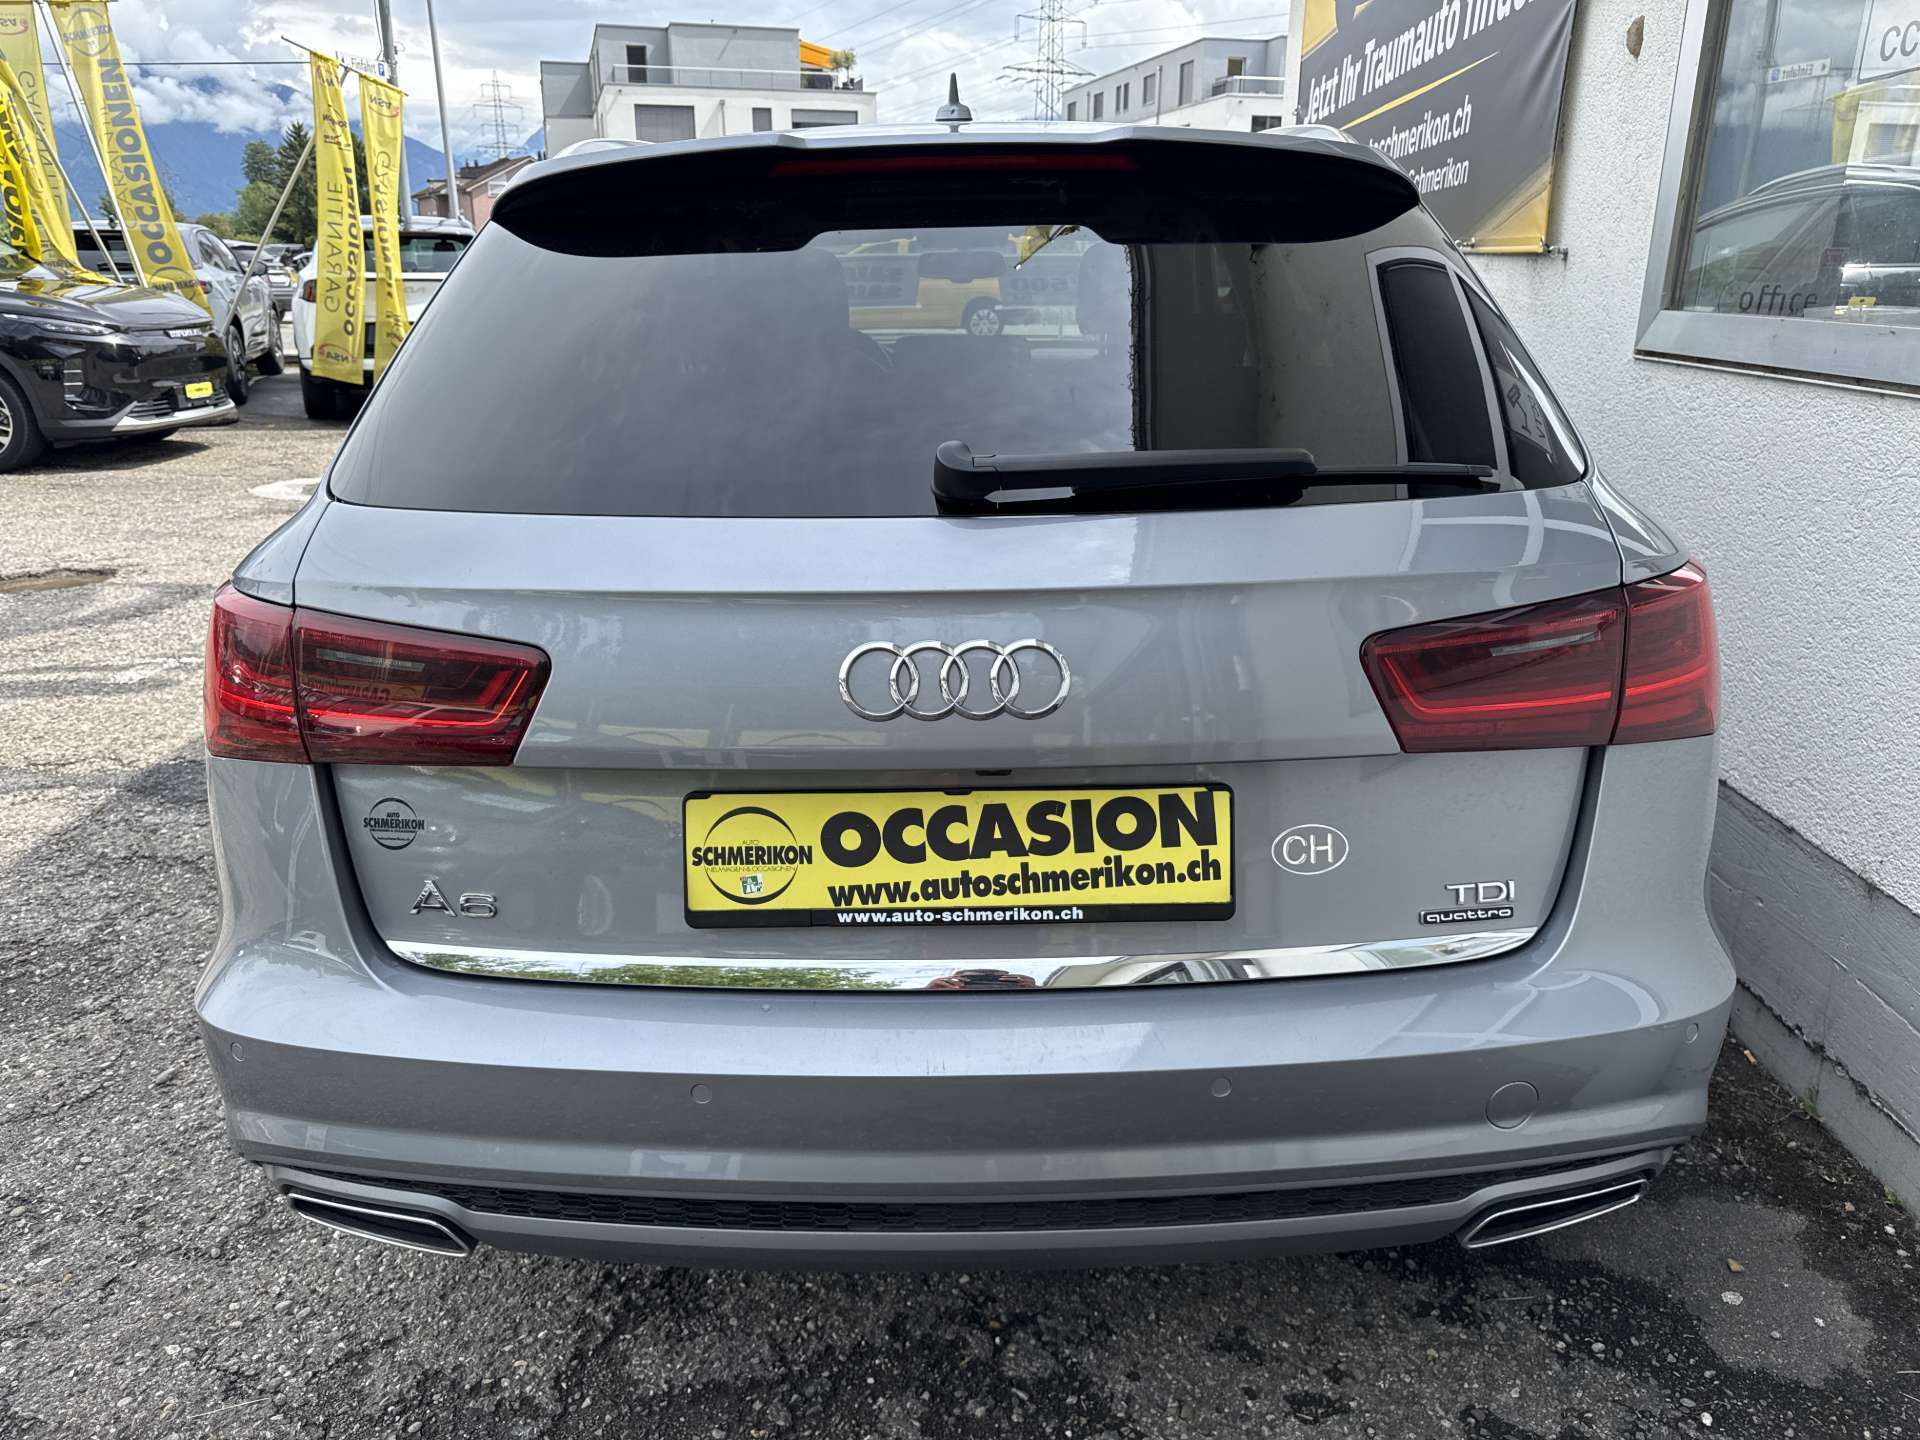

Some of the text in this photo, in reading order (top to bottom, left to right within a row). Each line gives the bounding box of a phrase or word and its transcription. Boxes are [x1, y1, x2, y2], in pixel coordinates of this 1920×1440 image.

[1304, 68, 1339, 124] Jetzt
[1339, 54, 1361, 110] Ihr
[1363, 1, 1460, 96] Traumauto
[97, 58, 173, 265] OCCASIONEN
[1739, 284, 1818, 317] office
[363, 817, 425, 830] SCHMERIKON
[820, 791, 1218, 868] OCCASION
[692, 845, 813, 866] SCHMERIKON
[1283, 833, 1333, 864] CH
[827, 849, 1221, 907] www.autoschmerikon.ch
[1445, 880, 1515, 905] TDI
[409, 880, 497, 918] A6
[837, 907, 1084, 923] www.auto-schmerikon.ch
[1426, 907, 1512, 923] quattro
